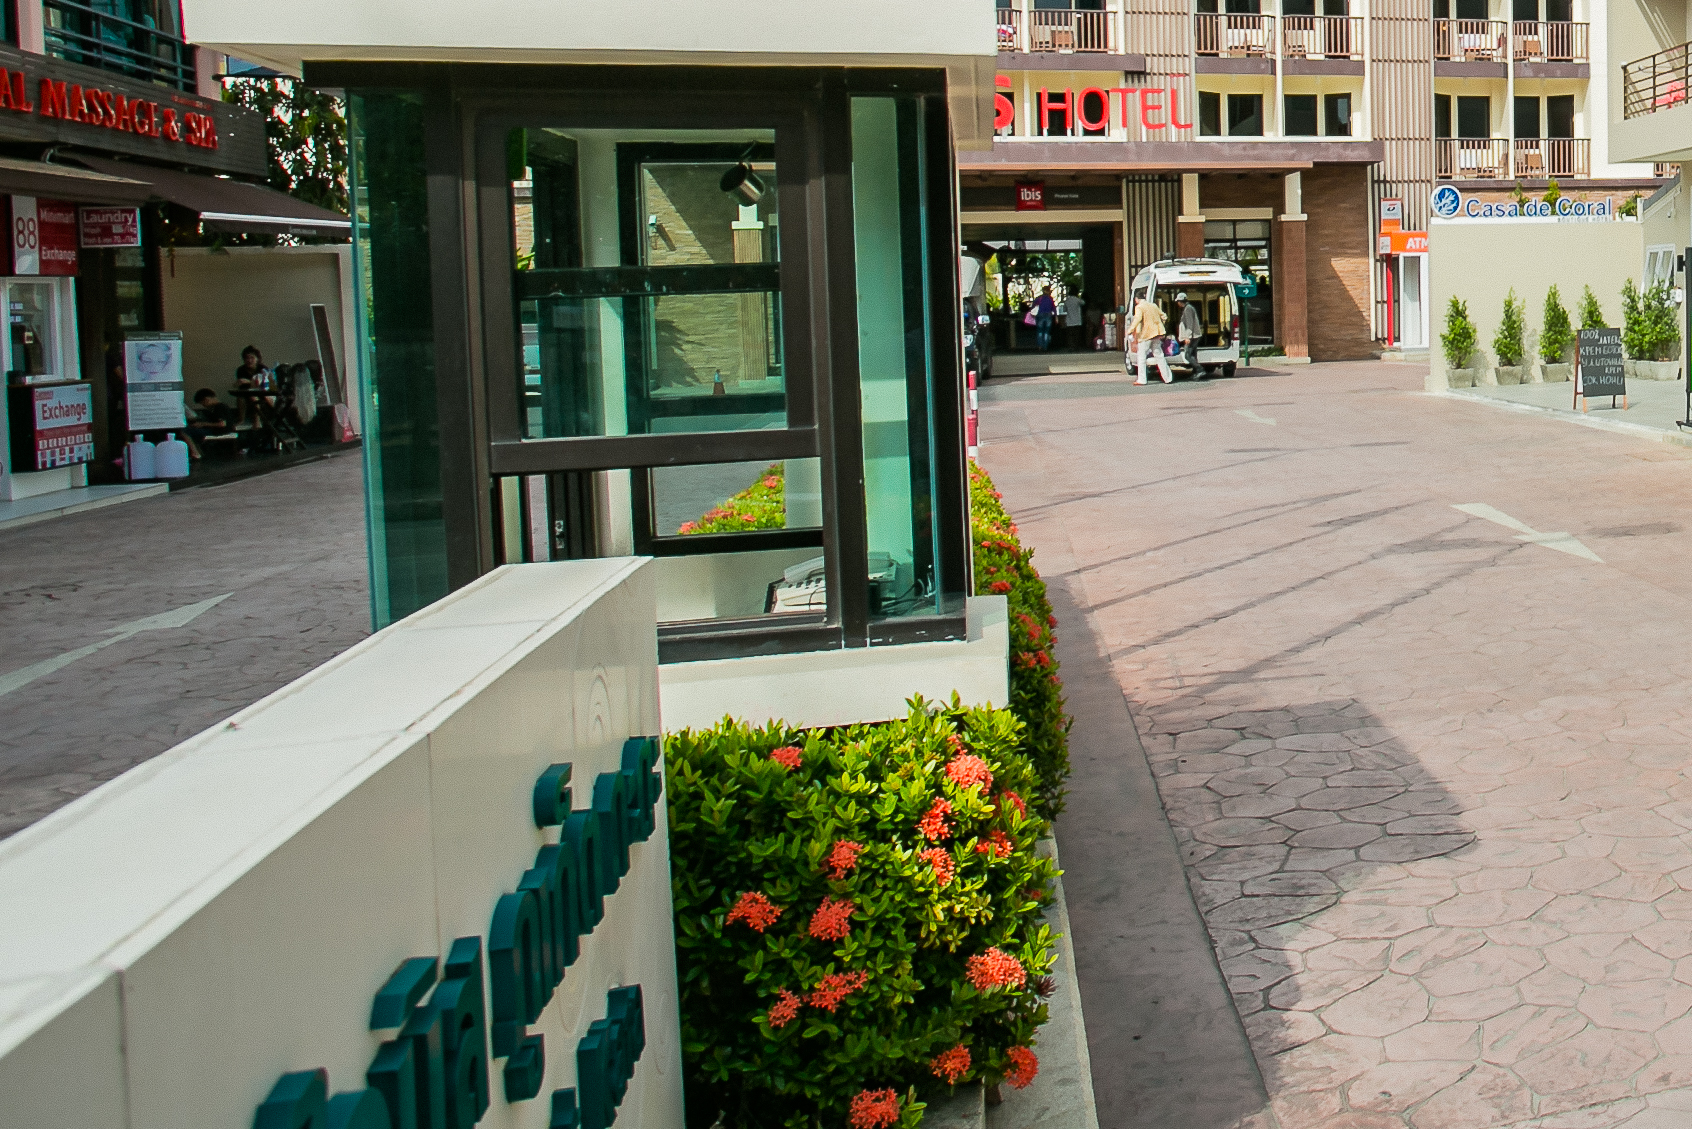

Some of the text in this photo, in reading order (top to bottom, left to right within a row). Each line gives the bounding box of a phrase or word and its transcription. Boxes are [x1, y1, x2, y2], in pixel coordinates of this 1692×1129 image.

[39, 78, 162, 138] MASSAGE
[163, 107, 183, 143] &
[184, 111, 219, 150] SPA
[1040, 86, 1194, 131] HOTEL
[1020, 187, 1042, 202] ibis
[83, 210, 134, 225] Laundry
[1465, 195, 1613, 218] Casa de Coral
[15, 216, 37, 249] 88
[41, 245, 76, 264] Exchange
[41, 400, 87, 422] Exchange
